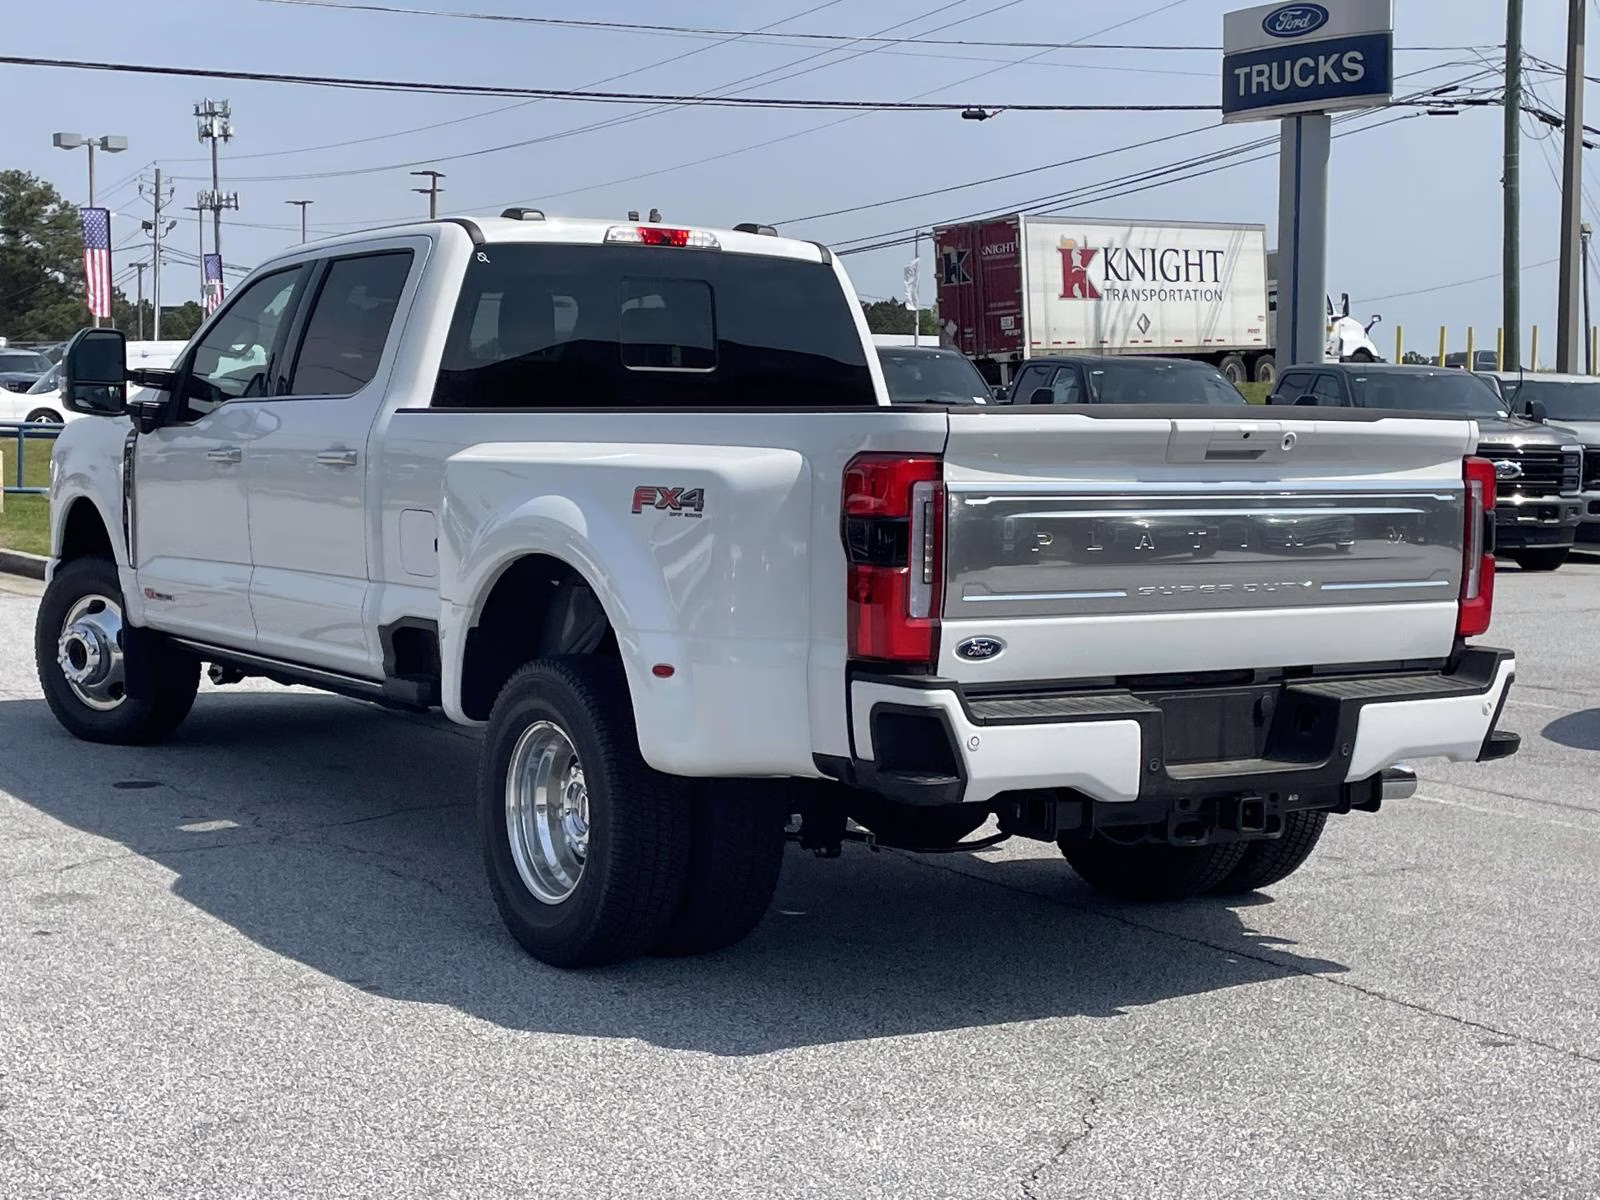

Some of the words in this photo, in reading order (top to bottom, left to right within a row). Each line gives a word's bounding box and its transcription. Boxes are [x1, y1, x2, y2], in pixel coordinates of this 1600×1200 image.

[1275, 10, 1312, 31] Ford
[1234, 50, 1365, 97] TRUCKS
[1102, 247, 1224, 283] KNIGHT
[1104, 288, 1224, 302] TRANSPORTATION
[631, 485, 705, 514] FX4
[1031, 526, 1408, 551] PLATINM
